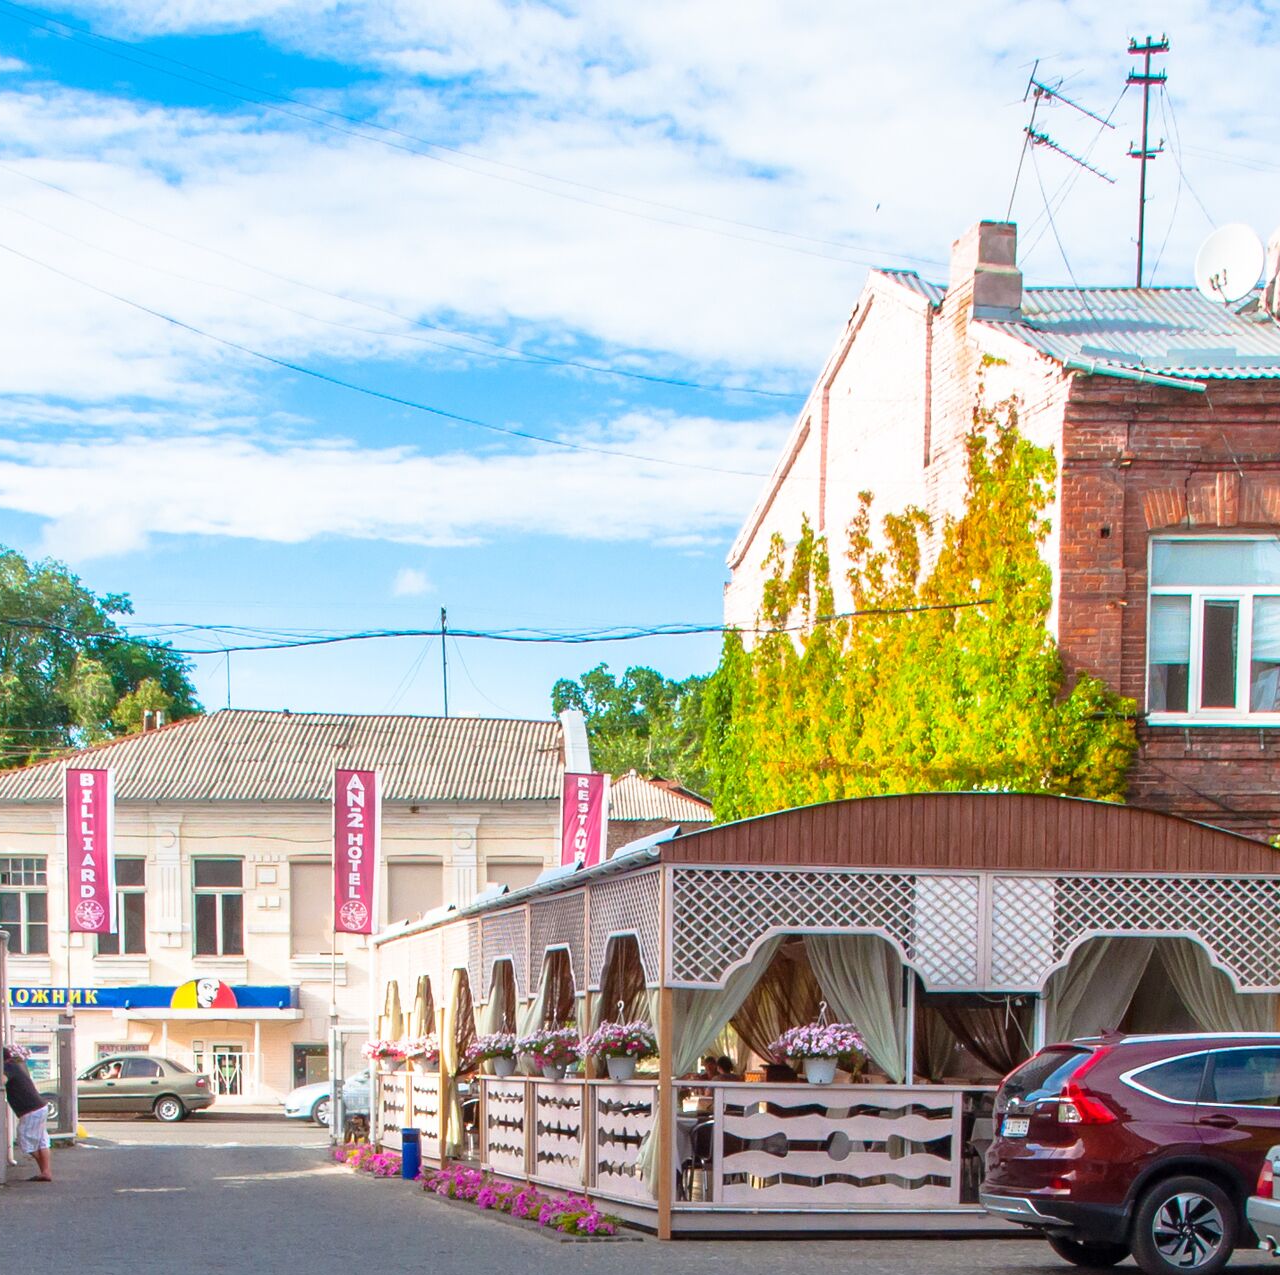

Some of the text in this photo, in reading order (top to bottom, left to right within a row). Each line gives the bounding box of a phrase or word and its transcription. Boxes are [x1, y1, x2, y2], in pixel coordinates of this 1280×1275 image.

[79, 773, 96, 898] BILLIARD
[346, 774, 365, 899] AN-2 HOTEL
[574, 777, 590, 863] RESTAUR
